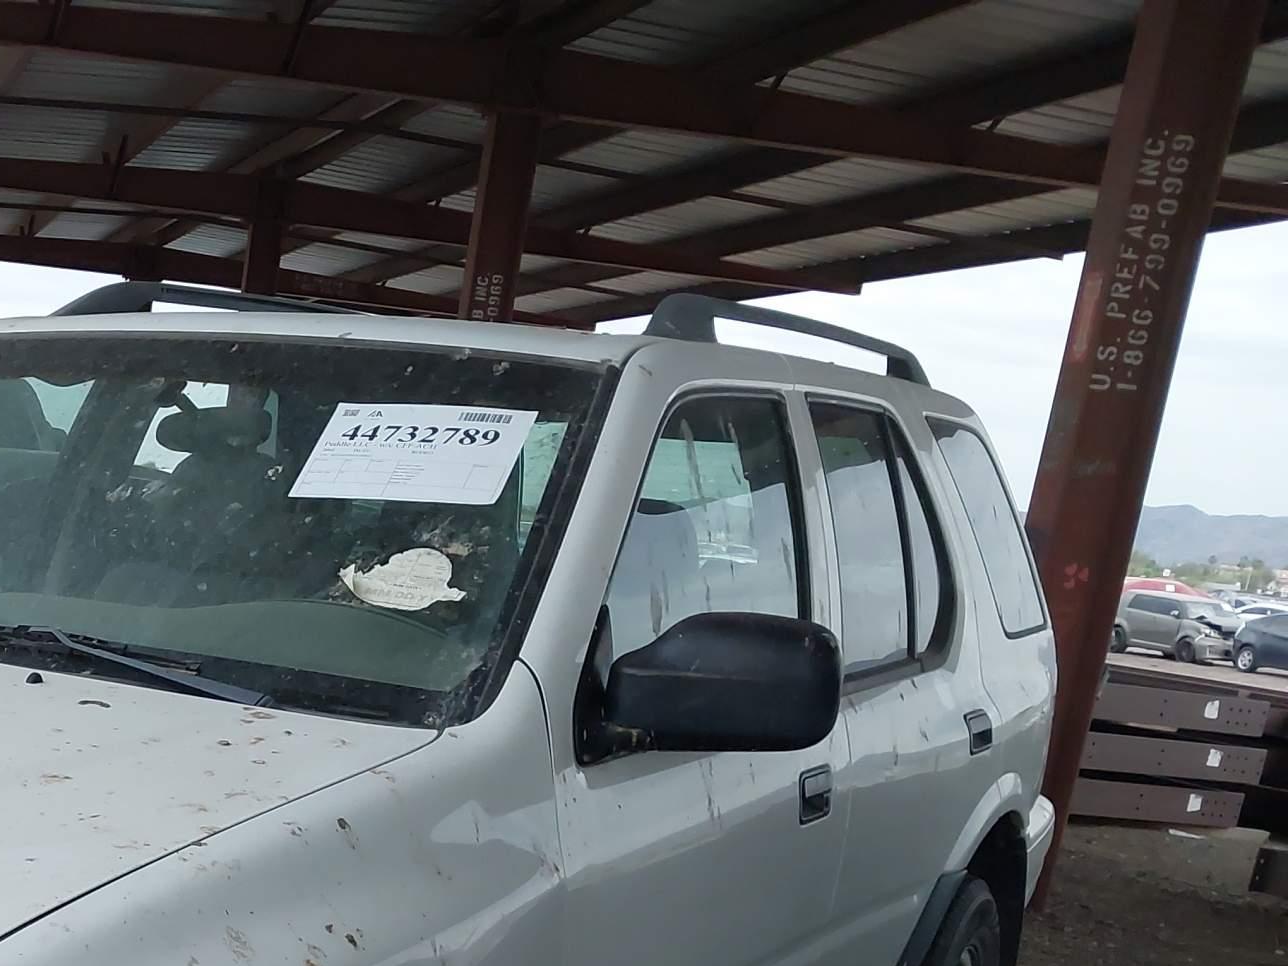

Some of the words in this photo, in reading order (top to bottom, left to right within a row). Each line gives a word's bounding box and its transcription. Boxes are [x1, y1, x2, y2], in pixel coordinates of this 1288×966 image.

[1089, 337, 1122, 391] U.S.
[1106, 202, 1151, 318] PREFAB
[1136, 130, 1170, 186] INC.
[341, 424, 501, 448] 44732789
